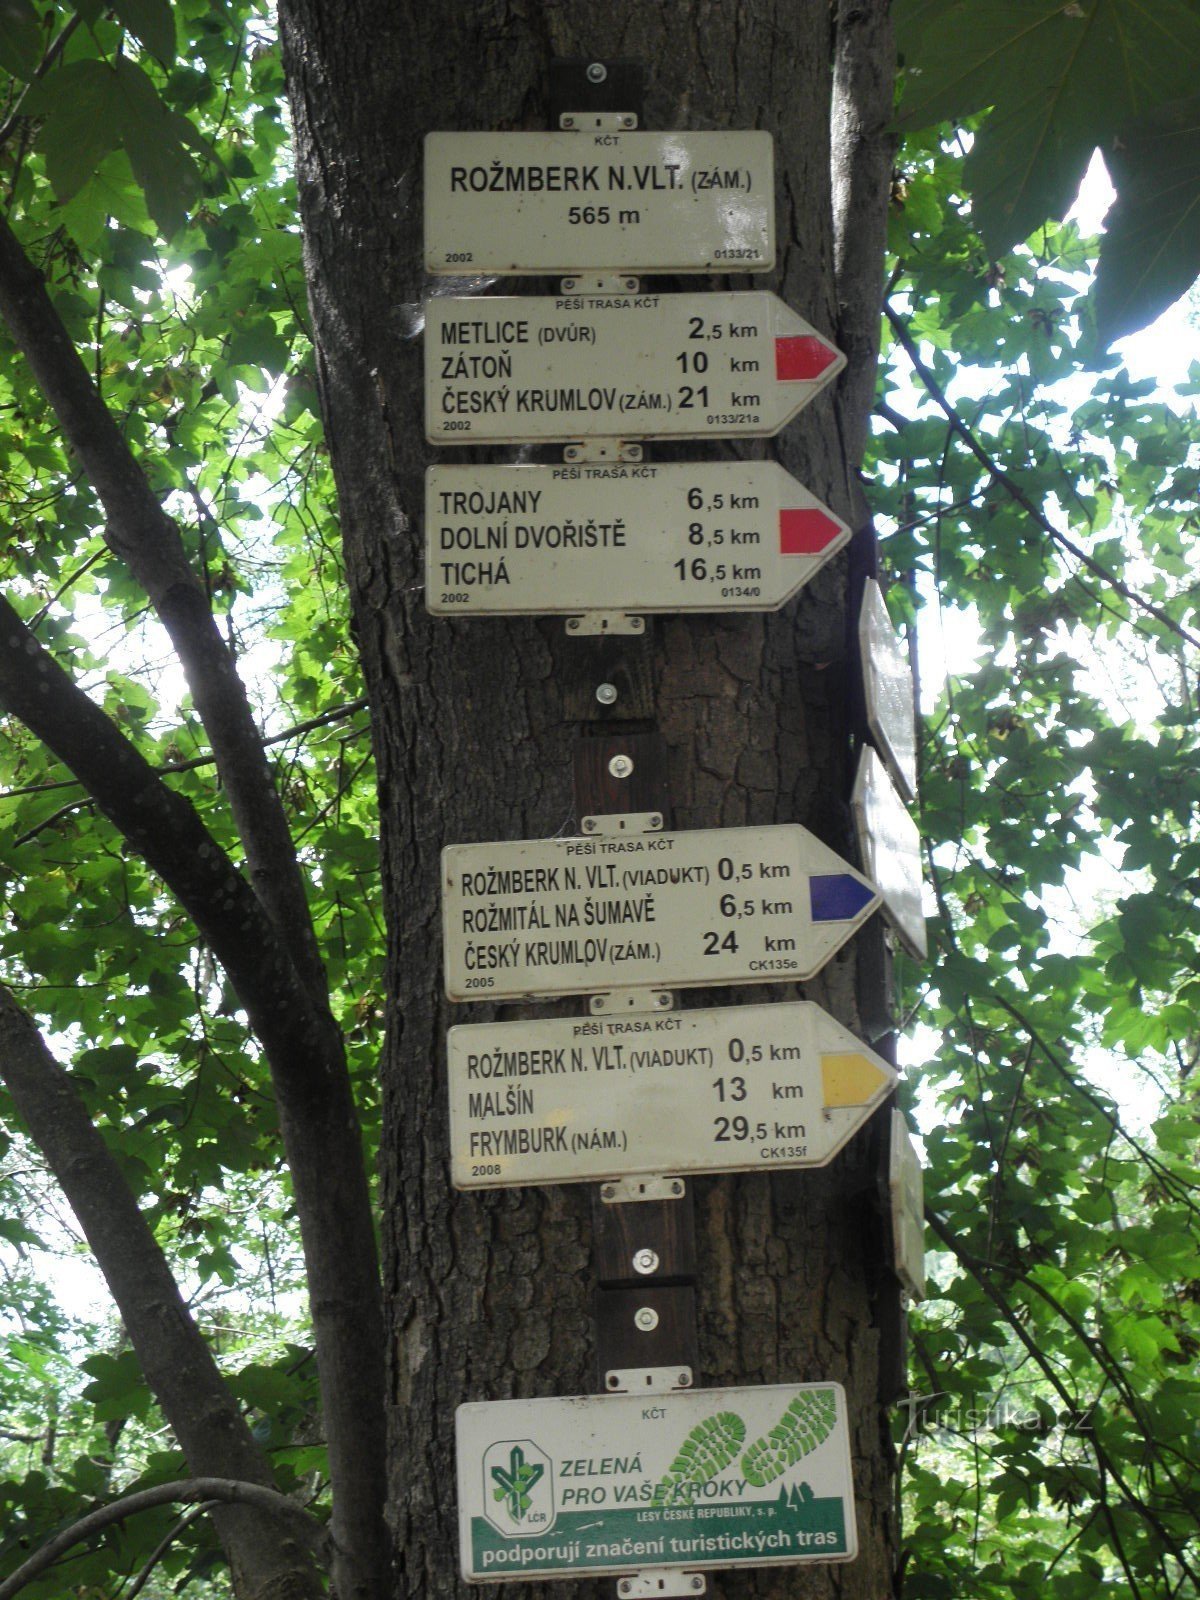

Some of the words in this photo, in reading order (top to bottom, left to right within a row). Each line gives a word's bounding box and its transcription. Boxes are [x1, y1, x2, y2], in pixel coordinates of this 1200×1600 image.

[594, 135, 619, 146] KČT
[450, 161, 600, 193] ROŽMBERK
[691, 169, 752, 192] (ZÁM.)
[568, 207, 610, 224] 565
[619, 210, 640, 223] m
[446, 253, 473, 262] 2002
[714, 249, 759, 260] 0133/21
[589, 300, 630, 309] TRASA
[634, 298, 659, 309] KČT
[441, 321, 528, 345] METLICE
[688, 318, 722, 341] 2,5
[729, 323, 758, 338] km
[441, 350, 512, 379] ZÁTOŇ
[677, 352, 709, 373] 10
[730, 357, 759, 372] km
[442, 385, 510, 414] ČESKÝ
[517, 388, 616, 412] KRUMLOV
[619, 393, 672, 412] (ZÁM.)
[678, 386, 709, 409] 21
[732, 393, 760, 407] km
[443, 421, 471, 431] 2002
[707, 414, 760, 425] 0133/21a
[585, 468, 628, 479] TRASA
[632, 466, 657, 478] KČT
[440, 490, 542, 514] TROJANY
[687, 488, 723, 511] 6,5
[730, 494, 759, 508] km
[441, 522, 508, 550] DOLNÍ
[515, 519, 626, 548] DVOŘIŠTĚ
[688, 523, 724, 546] 8,5
[731, 530, 761, 544] km
[440, 557, 511, 585] TICHÁ
[674, 558, 726, 582] 16,5
[733, 565, 761, 580] km
[441, 593, 469, 603] 2002
[600, 840, 644, 854] TRASA
[648, 839, 674, 852] KČT
[462, 865, 560, 897] ROŽMBERK
[564, 867, 582, 892] N.
[586, 865, 619, 890] VLT.
[622, 865, 710, 890] (VIADUKT)
[718, 858, 753, 883] 0,5
[760, 862, 790, 878] km
[463, 901, 550, 934] ROŽMITÁL
[555, 902, 580, 929] NA
[584, 893, 655, 926] ŠUMAVĚ
[720, 894, 755, 918] 6,5
[763, 900, 793, 916] km
[465, 938, 520, 970] ČESKÝ
[525, 939, 608, 967] KRUMLOV
[609, 942, 661, 965] (ZÁM.)
[703, 931, 738, 956] 24
[765, 936, 796, 952] km
[749, 959, 798, 971] CK135e
[465, 977, 494, 988] 2005
[607, 1022, 651, 1035] TRASA
[655, 1019, 682, 1032] KČT
[468, 1047, 566, 1079] ROŽMBERK
[571, 1048, 588, 1073] N.
[593, 1046, 626, 1071] VLT.
[630, 1048, 714, 1070] (VIADUKT)
[728, 1039, 762, 1063] 0,5
[770, 1044, 801, 1061] km
[469, 1084, 534, 1119] MALŠÍN
[712, 1077, 747, 1102] 13
[772, 1082, 803, 1099] km
[470, 1126, 568, 1157] FRYMBURK
[571, 1129, 628, 1155] (NÁM.)
[714, 1117, 767, 1143] 29,5
[774, 1122, 806, 1139] km
[761, 1146, 807, 1159] CK135f
[471, 1164, 501, 1176] 2008
[642, 1408, 667, 1420] KČT
[560, 1452, 643, 1478] ZELENÁ
[562, 1488, 607, 1505] PRO
[613, 1480, 666, 1502] VAŠE
[673, 1480, 748, 1499] KROKY
[637, 1510, 660, 1522] LESY
[663, 1506, 694, 1520] ČESKÉ
[482, 1543, 580, 1566] podporují
[586, 1537, 664, 1557] značení
[670, 1531, 791, 1553] turistických
[796, 1531, 838, 1546] tras
